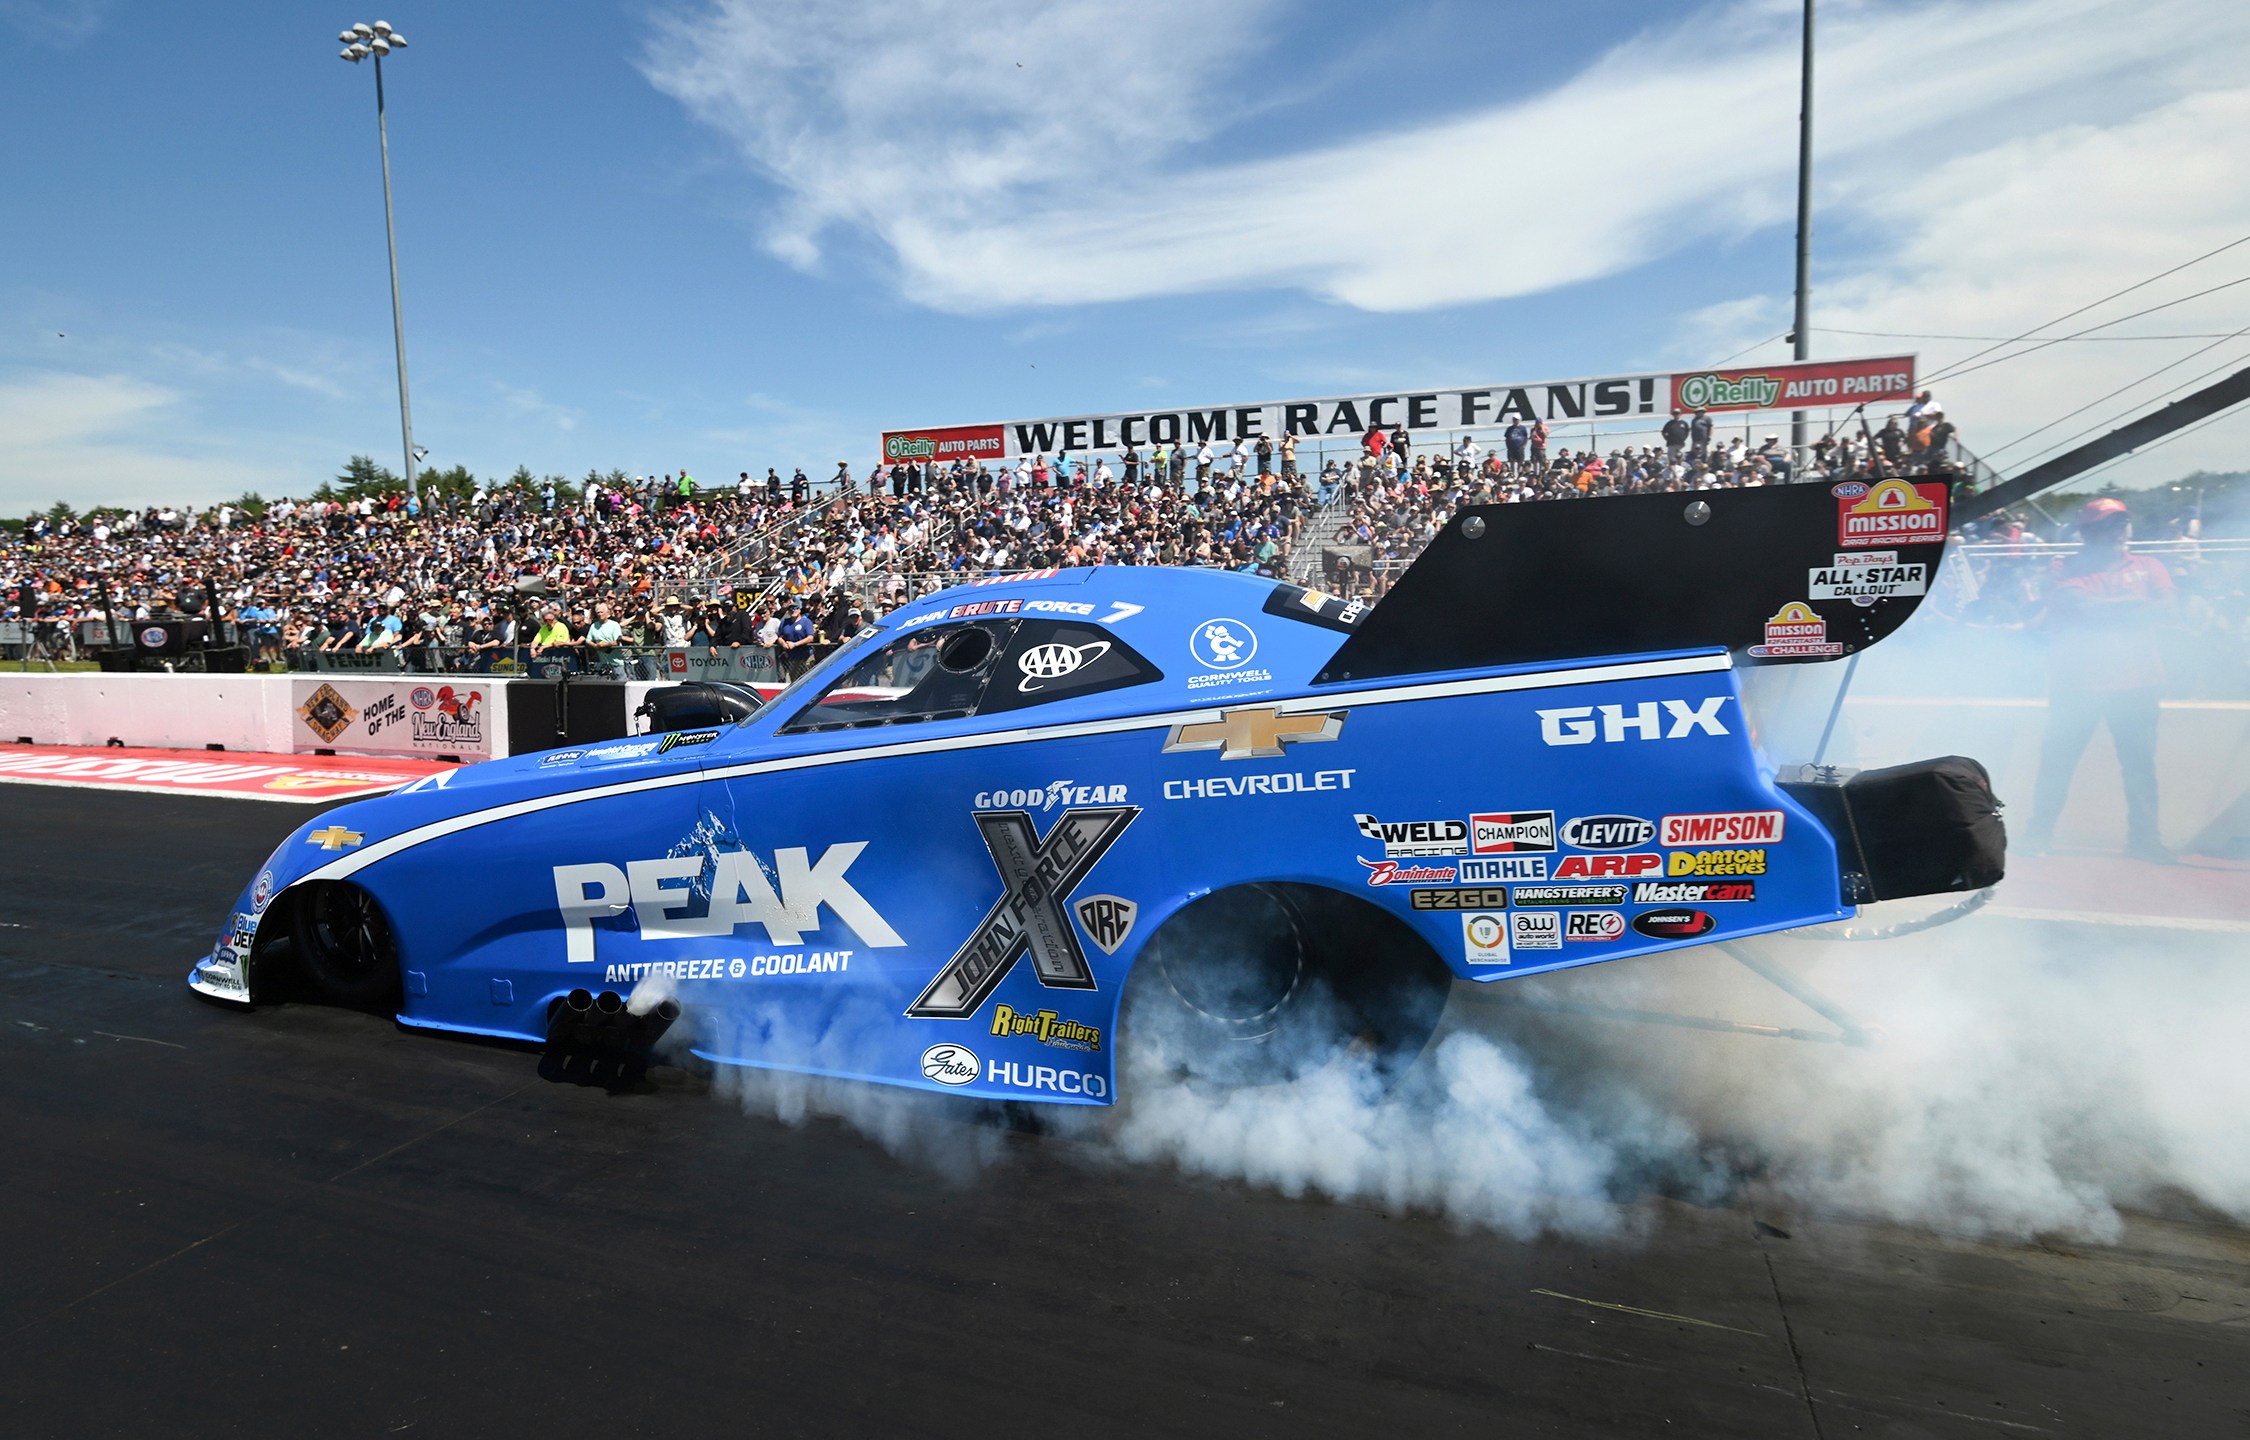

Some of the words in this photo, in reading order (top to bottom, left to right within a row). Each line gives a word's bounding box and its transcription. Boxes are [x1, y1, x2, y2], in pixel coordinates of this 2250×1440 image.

[1683, 375, 1779, 407] O'Reilly
[1785, 379, 1838, 398] AUTO
[1843, 374, 1907, 393] PARTS
[1015, 408, 1261, 453] WELCOME
[1285, 394, 1438, 435] RACE
[1462, 378, 1654, 425] FANS!
[887, 436, 936, 457] O'Reilly
[939, 440, 965, 453] AUTO
[968, 438, 999, 450] PARTS
[1838, 485, 1868, 496] NHRA
[1848, 513, 1936, 532] MISSION
[1837, 556, 1861, 565] Pep
[1863, 555, 1893, 565] Boys
[1814, 569, 1853, 585] ALL
[1866, 567, 1922, 583] STAR
[1834, 585, 1896, 596] CALLOUT
[896, 610, 948, 630] JOHN
[948, 599, 1023, 619] BRUTE
[1023, 601, 1096, 615] FORCE
[1098, 602, 1145, 624] 7
[1027, 646, 1075, 674] AAA
[1772, 645, 1838, 654] CHALLENGE
[325, 653, 384, 668] FENDT
[690, 657, 729, 668] TOYOTA
[742, 656, 770, 669] NHRA
[1188, 669, 1270, 683] CORNWELL
[1188, 679, 1232, 689] QUALITY
[1237, 675, 1272, 683] TOOLS
[363, 694, 394, 721] HOME
[413, 691, 432, 707] NHRA
[368, 718, 382, 736] OF
[385, 705, 405, 728] THE
[412, 712, 435, 740] New
[435, 712, 482, 743] England
[1535, 697, 1730, 746] GHX
[679, 732, 718, 741] MONSTER
[1163, 769, 1356, 800] CHEVROLET
[1381, 822, 1467, 843] WELD
[1478, 826, 1549, 841] CHAMPION
[1564, 819, 1653, 845] CLEVITE
[1668, 816, 1775, 842] SIMPSON
[999, 823, 1024, 866] next
[1387, 847, 1468, 857] RACING
[1360, 861, 1456, 886] Boninfante
[1463, 859, 1545, 879] MAHLE
[1555, 855, 1661, 877] ARP
[1695, 863, 1765, 876] SLEEVES
[552, 841, 908, 963] PEAK
[1415, 889, 1504, 908] EZGO
[1515, 887, 1623, 899] HANGSTERFER'S
[1635, 883, 1753, 901] Mastercam
[953, 913, 1015, 1001] JOHN
[1010, 820, 1088, 927] FORCE
[237, 915, 257, 932] Blue
[751, 950, 853, 976] COOLANT
[931, 1051, 976, 1080] Gates
[988, 1059, 1106, 1097] HURCO
